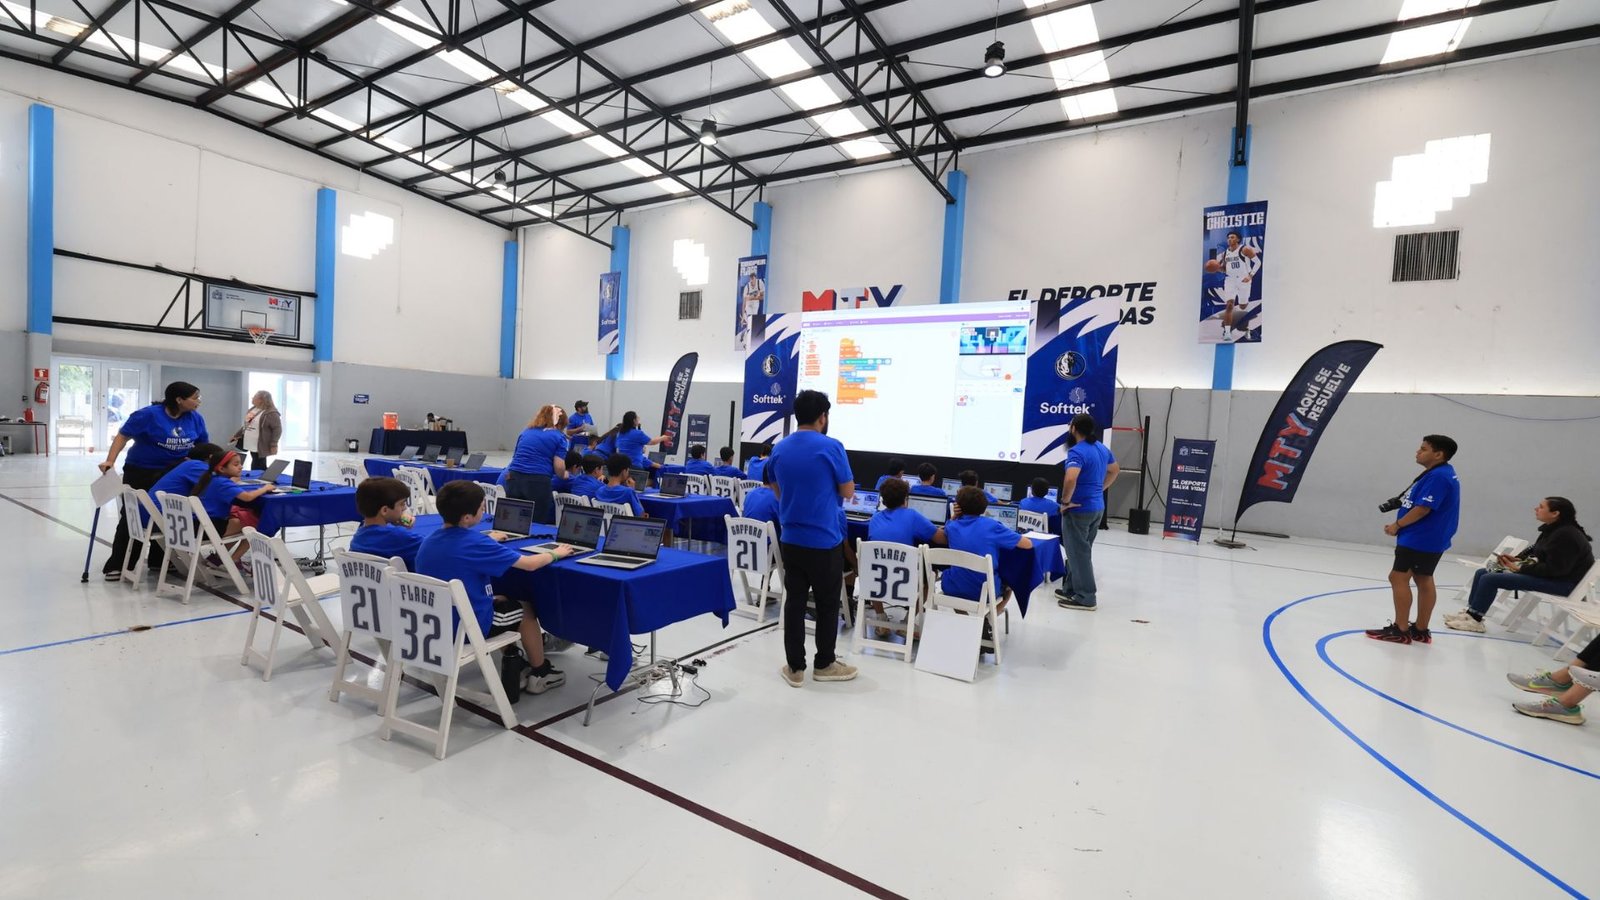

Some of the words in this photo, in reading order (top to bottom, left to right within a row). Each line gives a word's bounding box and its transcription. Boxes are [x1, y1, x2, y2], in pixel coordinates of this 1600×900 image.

[1207, 212, 1264, 230] CHRISTIE
[269, 297, 292, 308] MTY
[1040, 282, 1157, 302] DEPORTE
[752, 394, 783, 404] Softtek
[1296, 382, 1321, 416] AQUÍ
[1315, 367, 1332, 384] SE
[1307, 363, 1351, 421] RESUELVE
[1040, 402, 1090, 414] Softtek
[1257, 412, 1313, 490] MTY
[167, 513, 189, 547] 32
[731, 524, 762, 539] GAFFORD
[1171, 514, 1198, 528] MTY
[736, 540, 758, 571] 21
[874, 547, 907, 563] FLAGG
[255, 559, 275, 605] 00
[342, 561, 382, 584] GAFFORD
[870, 563, 911, 602] 32
[400, 584, 435, 608] FLAGG
[351, 585, 381, 633] 21
[400, 607, 442, 667] 32
